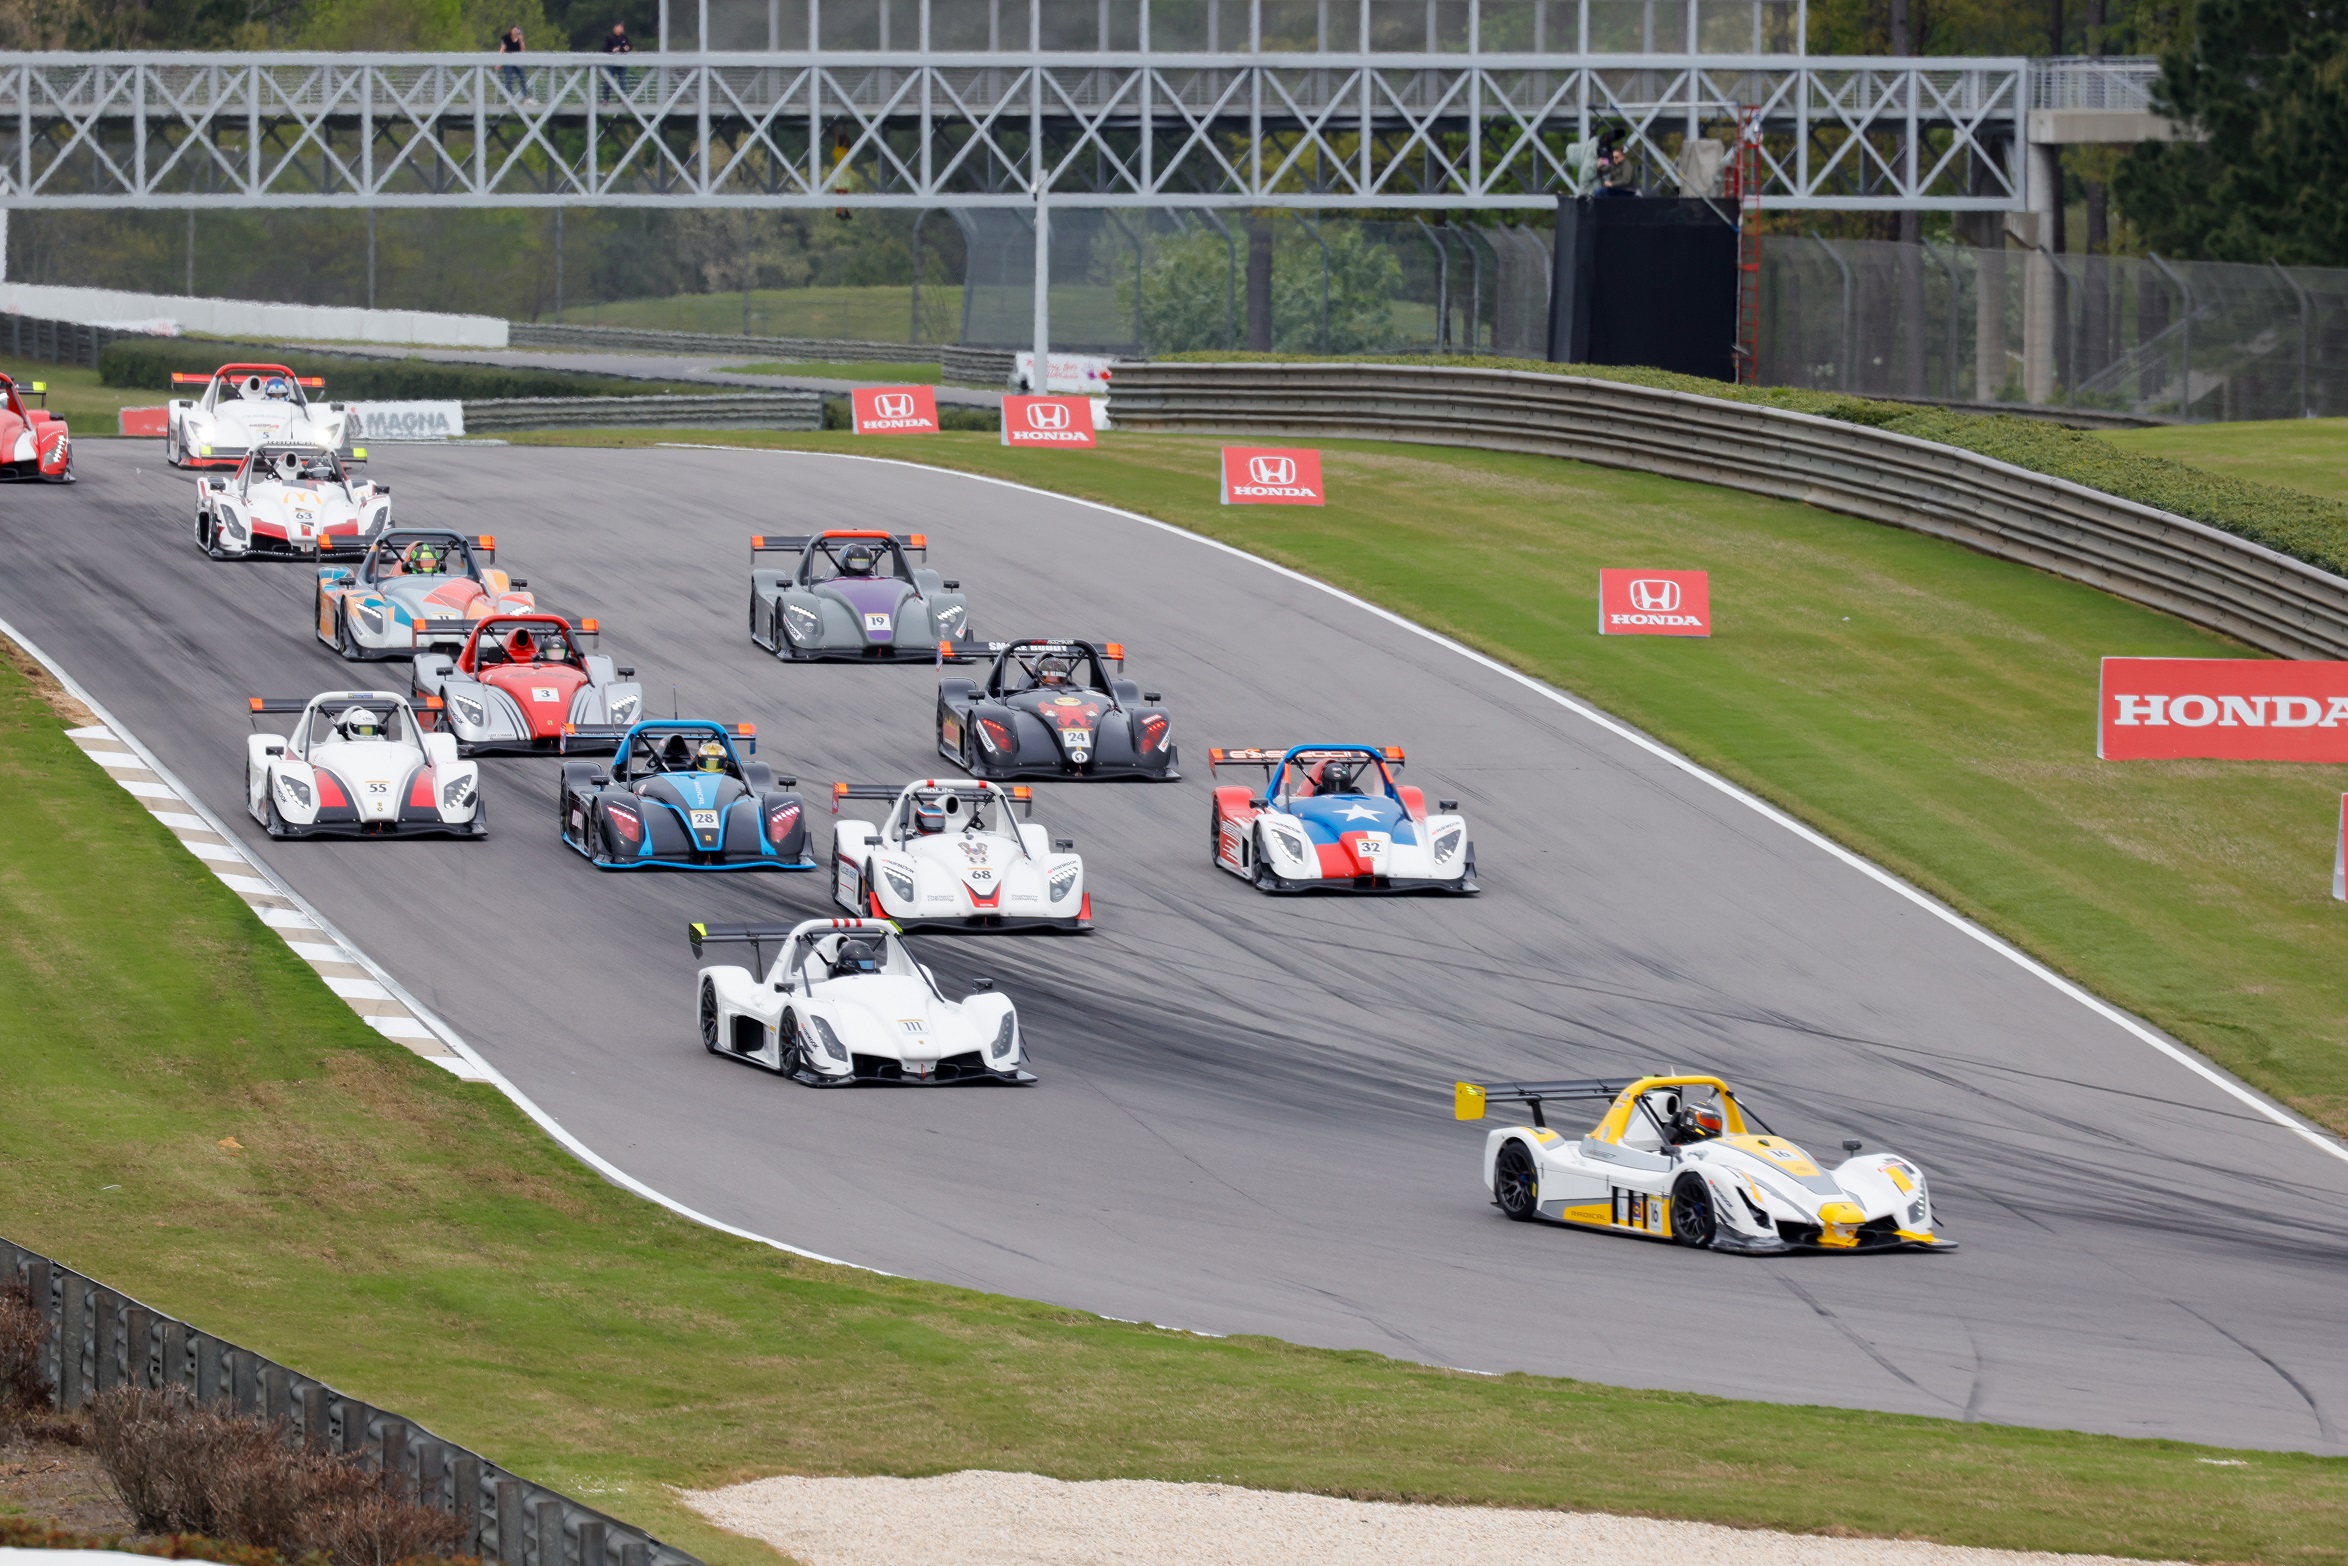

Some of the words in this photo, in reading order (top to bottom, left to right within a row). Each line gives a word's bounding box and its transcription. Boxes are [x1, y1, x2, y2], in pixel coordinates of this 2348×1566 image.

[366, 411, 450, 435] MAGNA
[863, 418, 932, 429] HONDA
[1013, 431, 1090, 441] HONDA
[1234, 486, 1317, 497] HONDA
[295, 512, 313, 520] 63
[871, 617, 885, 626] 19
[1611, 614, 1702, 626] HONDA
[541, 690, 550, 698] 3
[2114, 695, 2348, 727] HONDA
[1068, 732, 1086, 742] 24
[369, 783, 387, 793] 55
[694, 813, 715, 824] 28
[1361, 843, 1381, 853] 32
[971, 870, 992, 880] 68
[903, 1021, 923, 1032] 111
[1772, 1150, 1791, 1159] 16
[1570, 1210, 1607, 1221] RADICAL
[1650, 1202, 1659, 1223] 16
